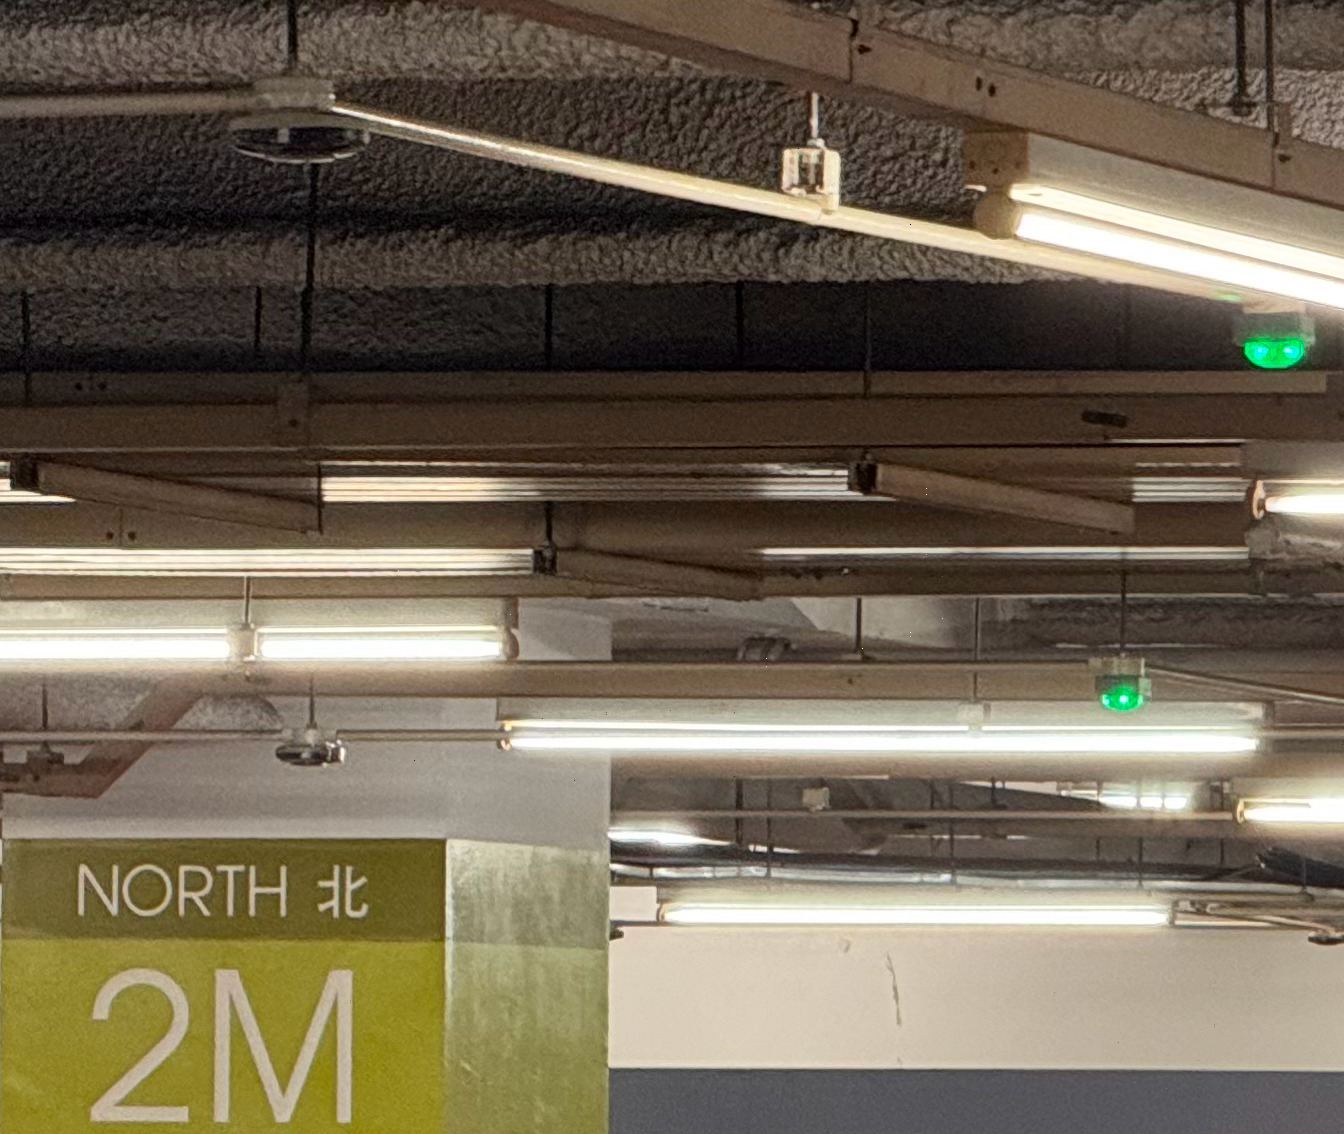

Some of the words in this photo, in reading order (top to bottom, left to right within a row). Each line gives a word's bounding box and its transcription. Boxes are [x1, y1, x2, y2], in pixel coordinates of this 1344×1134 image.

[78, 864, 287, 918] NORTH
[318, 864, 368, 919] 北
[90, 968, 354, 1124] 2M
